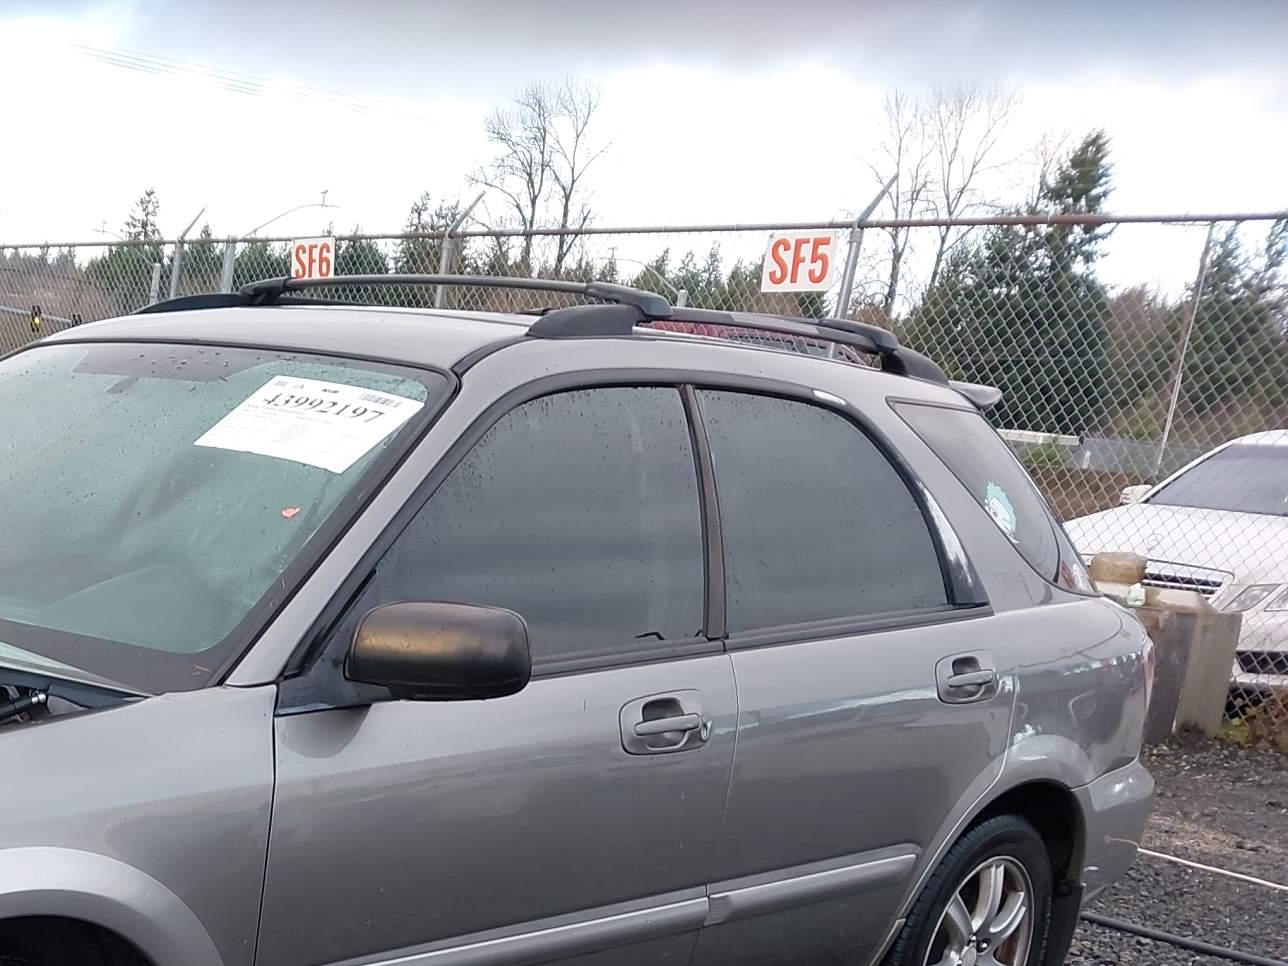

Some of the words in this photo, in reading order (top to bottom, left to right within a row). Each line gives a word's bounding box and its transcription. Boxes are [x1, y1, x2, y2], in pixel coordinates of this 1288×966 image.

[294, 242, 331, 280] SF6
[768, 236, 831, 285] SF5
[263, 392, 385, 424] 43992197
